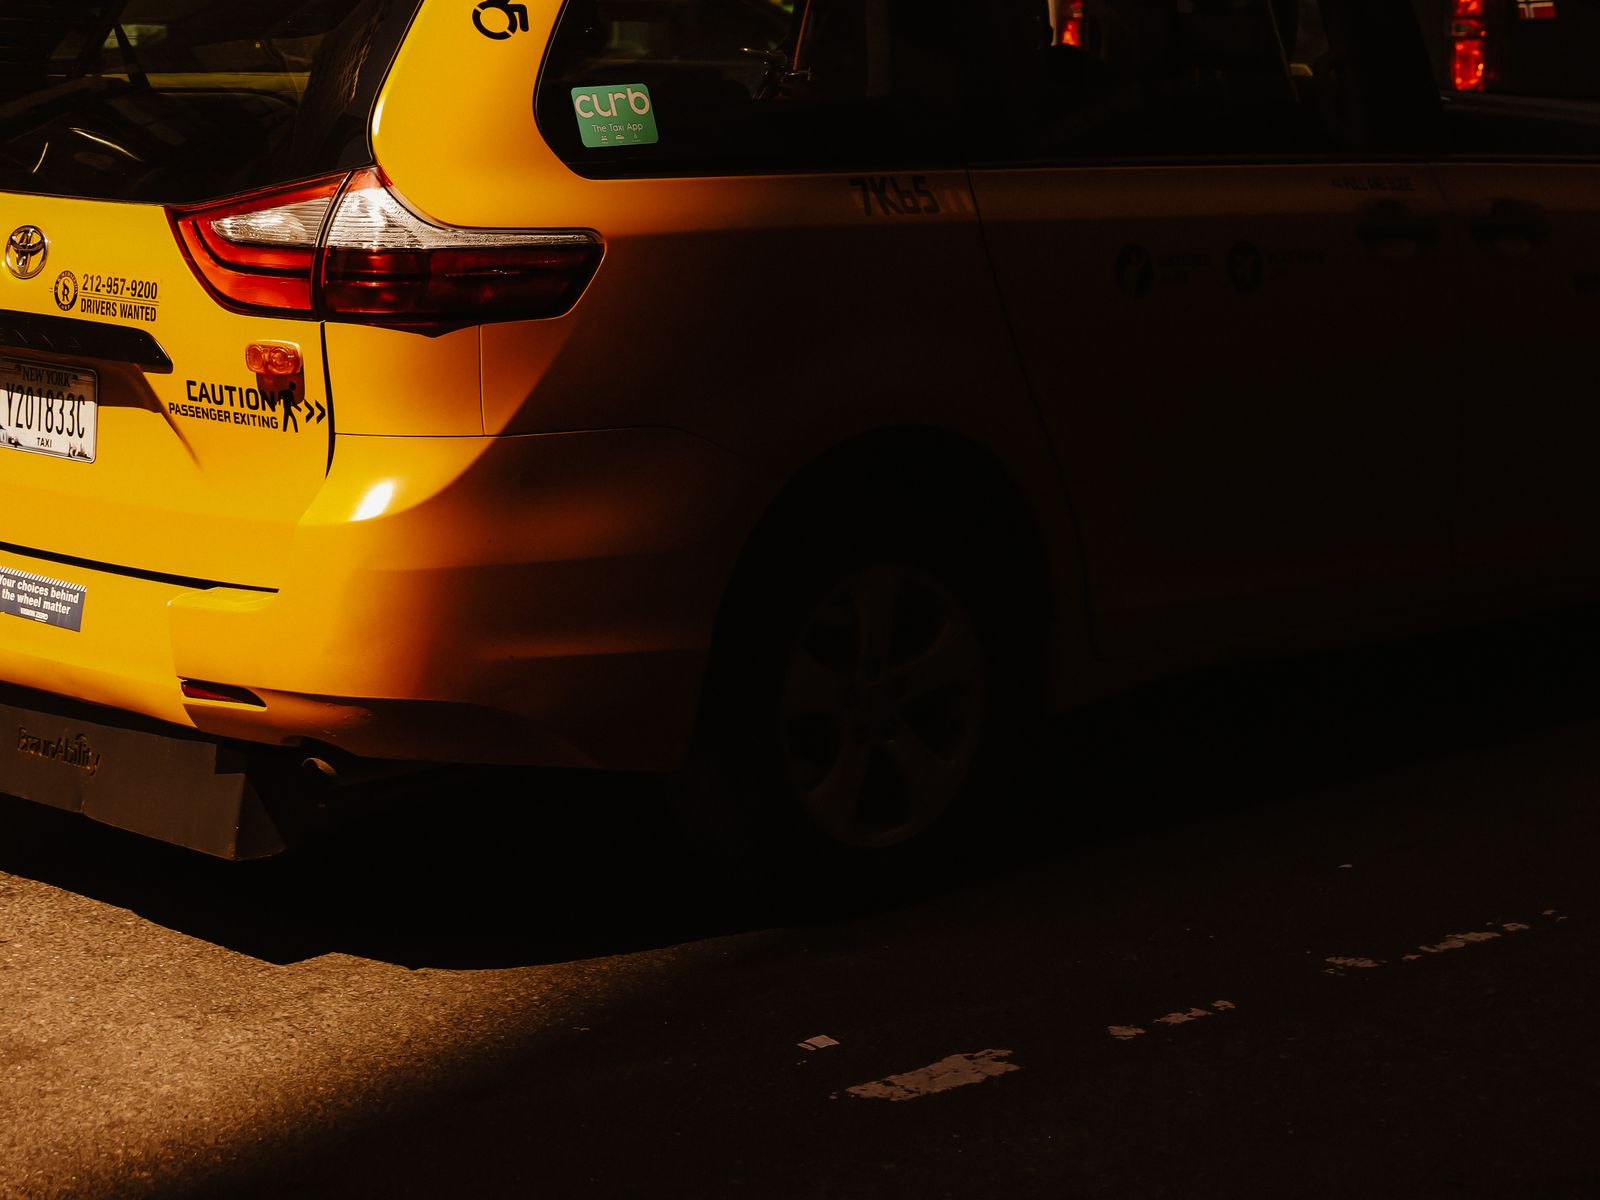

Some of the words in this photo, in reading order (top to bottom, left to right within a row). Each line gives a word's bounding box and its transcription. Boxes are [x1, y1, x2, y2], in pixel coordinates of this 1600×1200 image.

[575, 87, 650, 118] curb
[592, 124, 608, 133] The
[609, 123, 625, 132] Taxi
[627, 122, 644, 132] App
[82, 273, 158, 300] 212-957-9200
[80, 298, 117, 318] DRIVERS
[119, 303, 157, 322] WANTED
[22, 366, 44, 383] NEW
[46, 369, 71, 388] YORK
[186, 380, 277, 413] CAUTION
[6, 382, 86, 439] Y201833C
[168, 402, 231, 424] PASSENGER
[233, 412, 279, 430] EXITING
[37, 437, 53, 448] TAXI
[2, 588, 16, 601] the
[17, 593, 42, 608] wheel
[43, 600, 72, 615] matter
[17, 579, 50, 597] choices
[51, 586, 80, 604] behind
